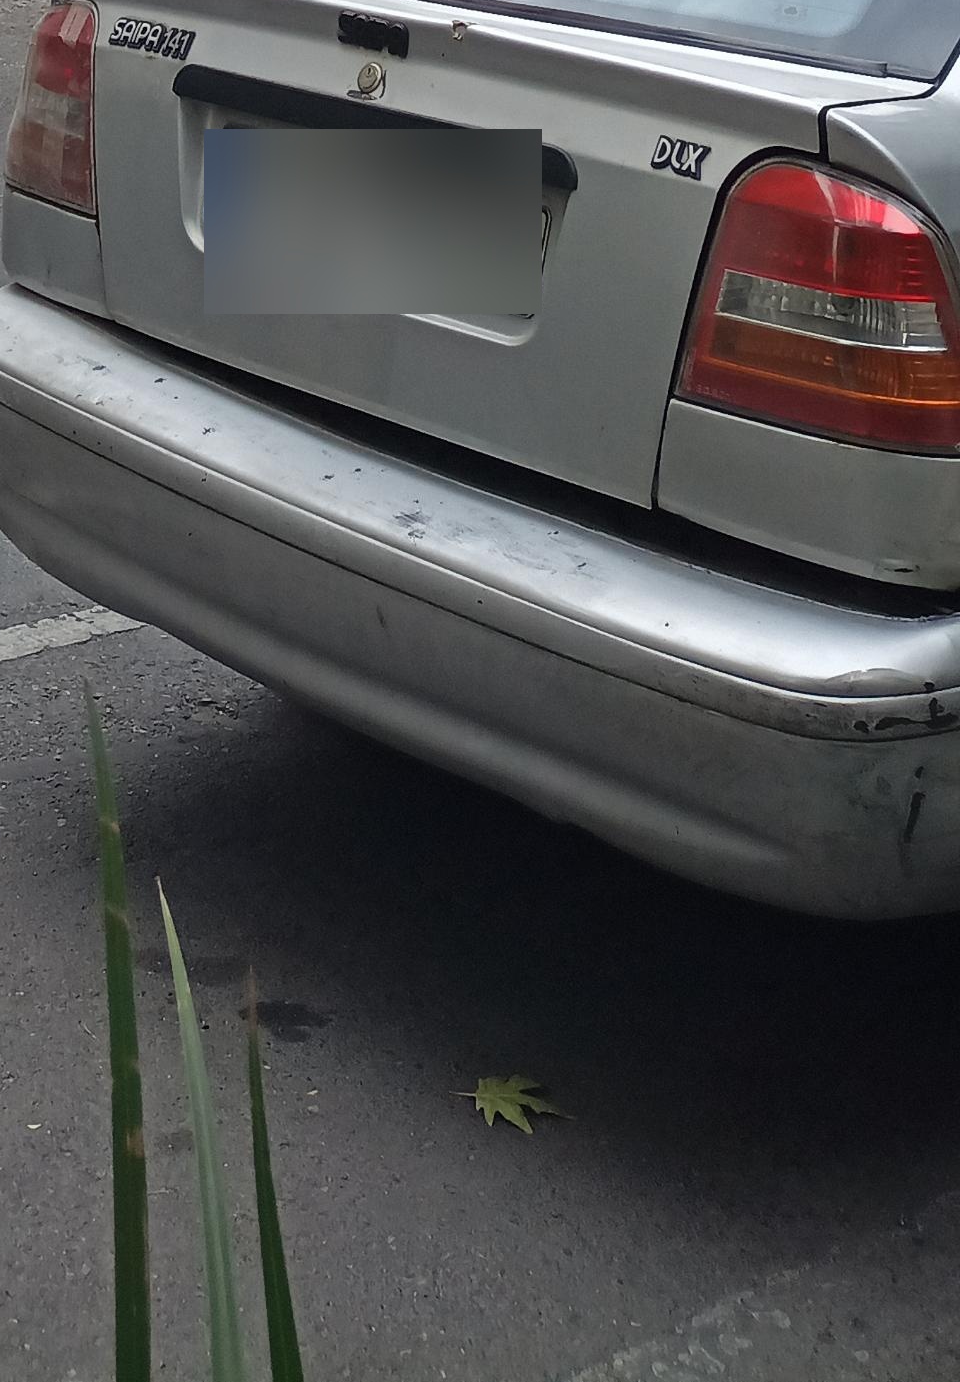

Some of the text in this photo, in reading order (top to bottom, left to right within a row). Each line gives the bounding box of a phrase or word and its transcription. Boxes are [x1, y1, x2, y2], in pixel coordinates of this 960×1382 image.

[109, 17, 196, 60] SAIPA 141
[651, 135, 711, 180] DLX
